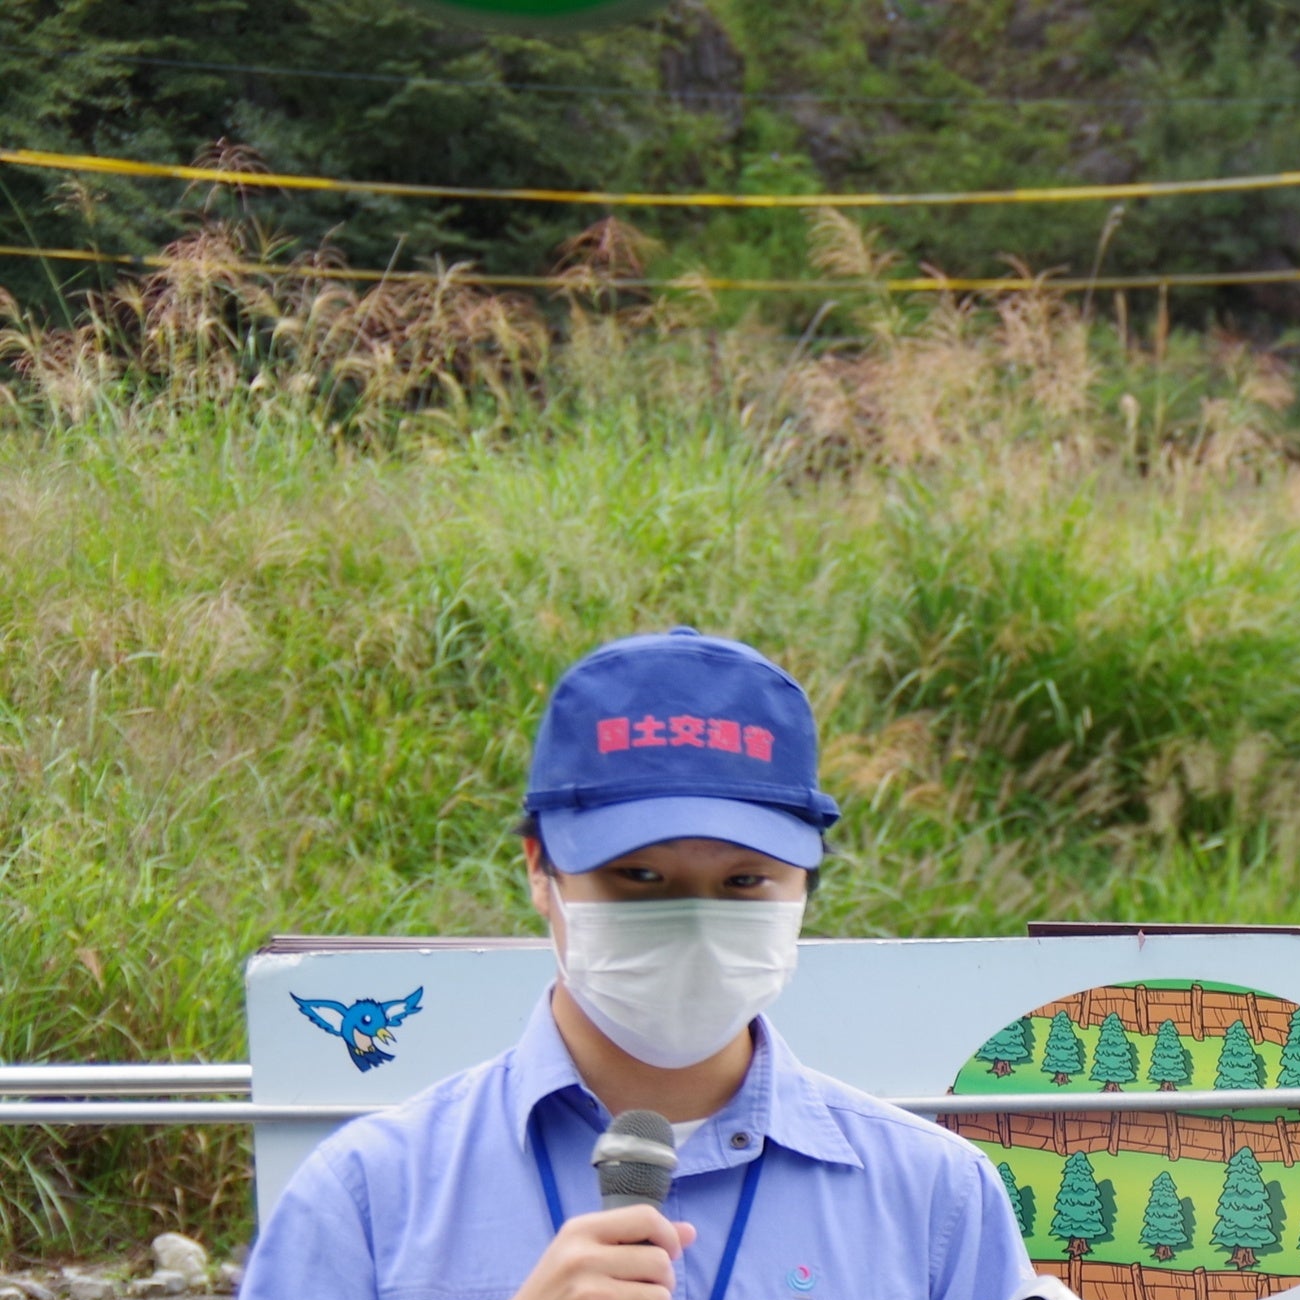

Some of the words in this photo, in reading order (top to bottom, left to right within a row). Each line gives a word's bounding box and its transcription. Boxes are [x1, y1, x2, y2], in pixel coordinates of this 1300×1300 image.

[596, 714, 776, 764] 国土交通省
